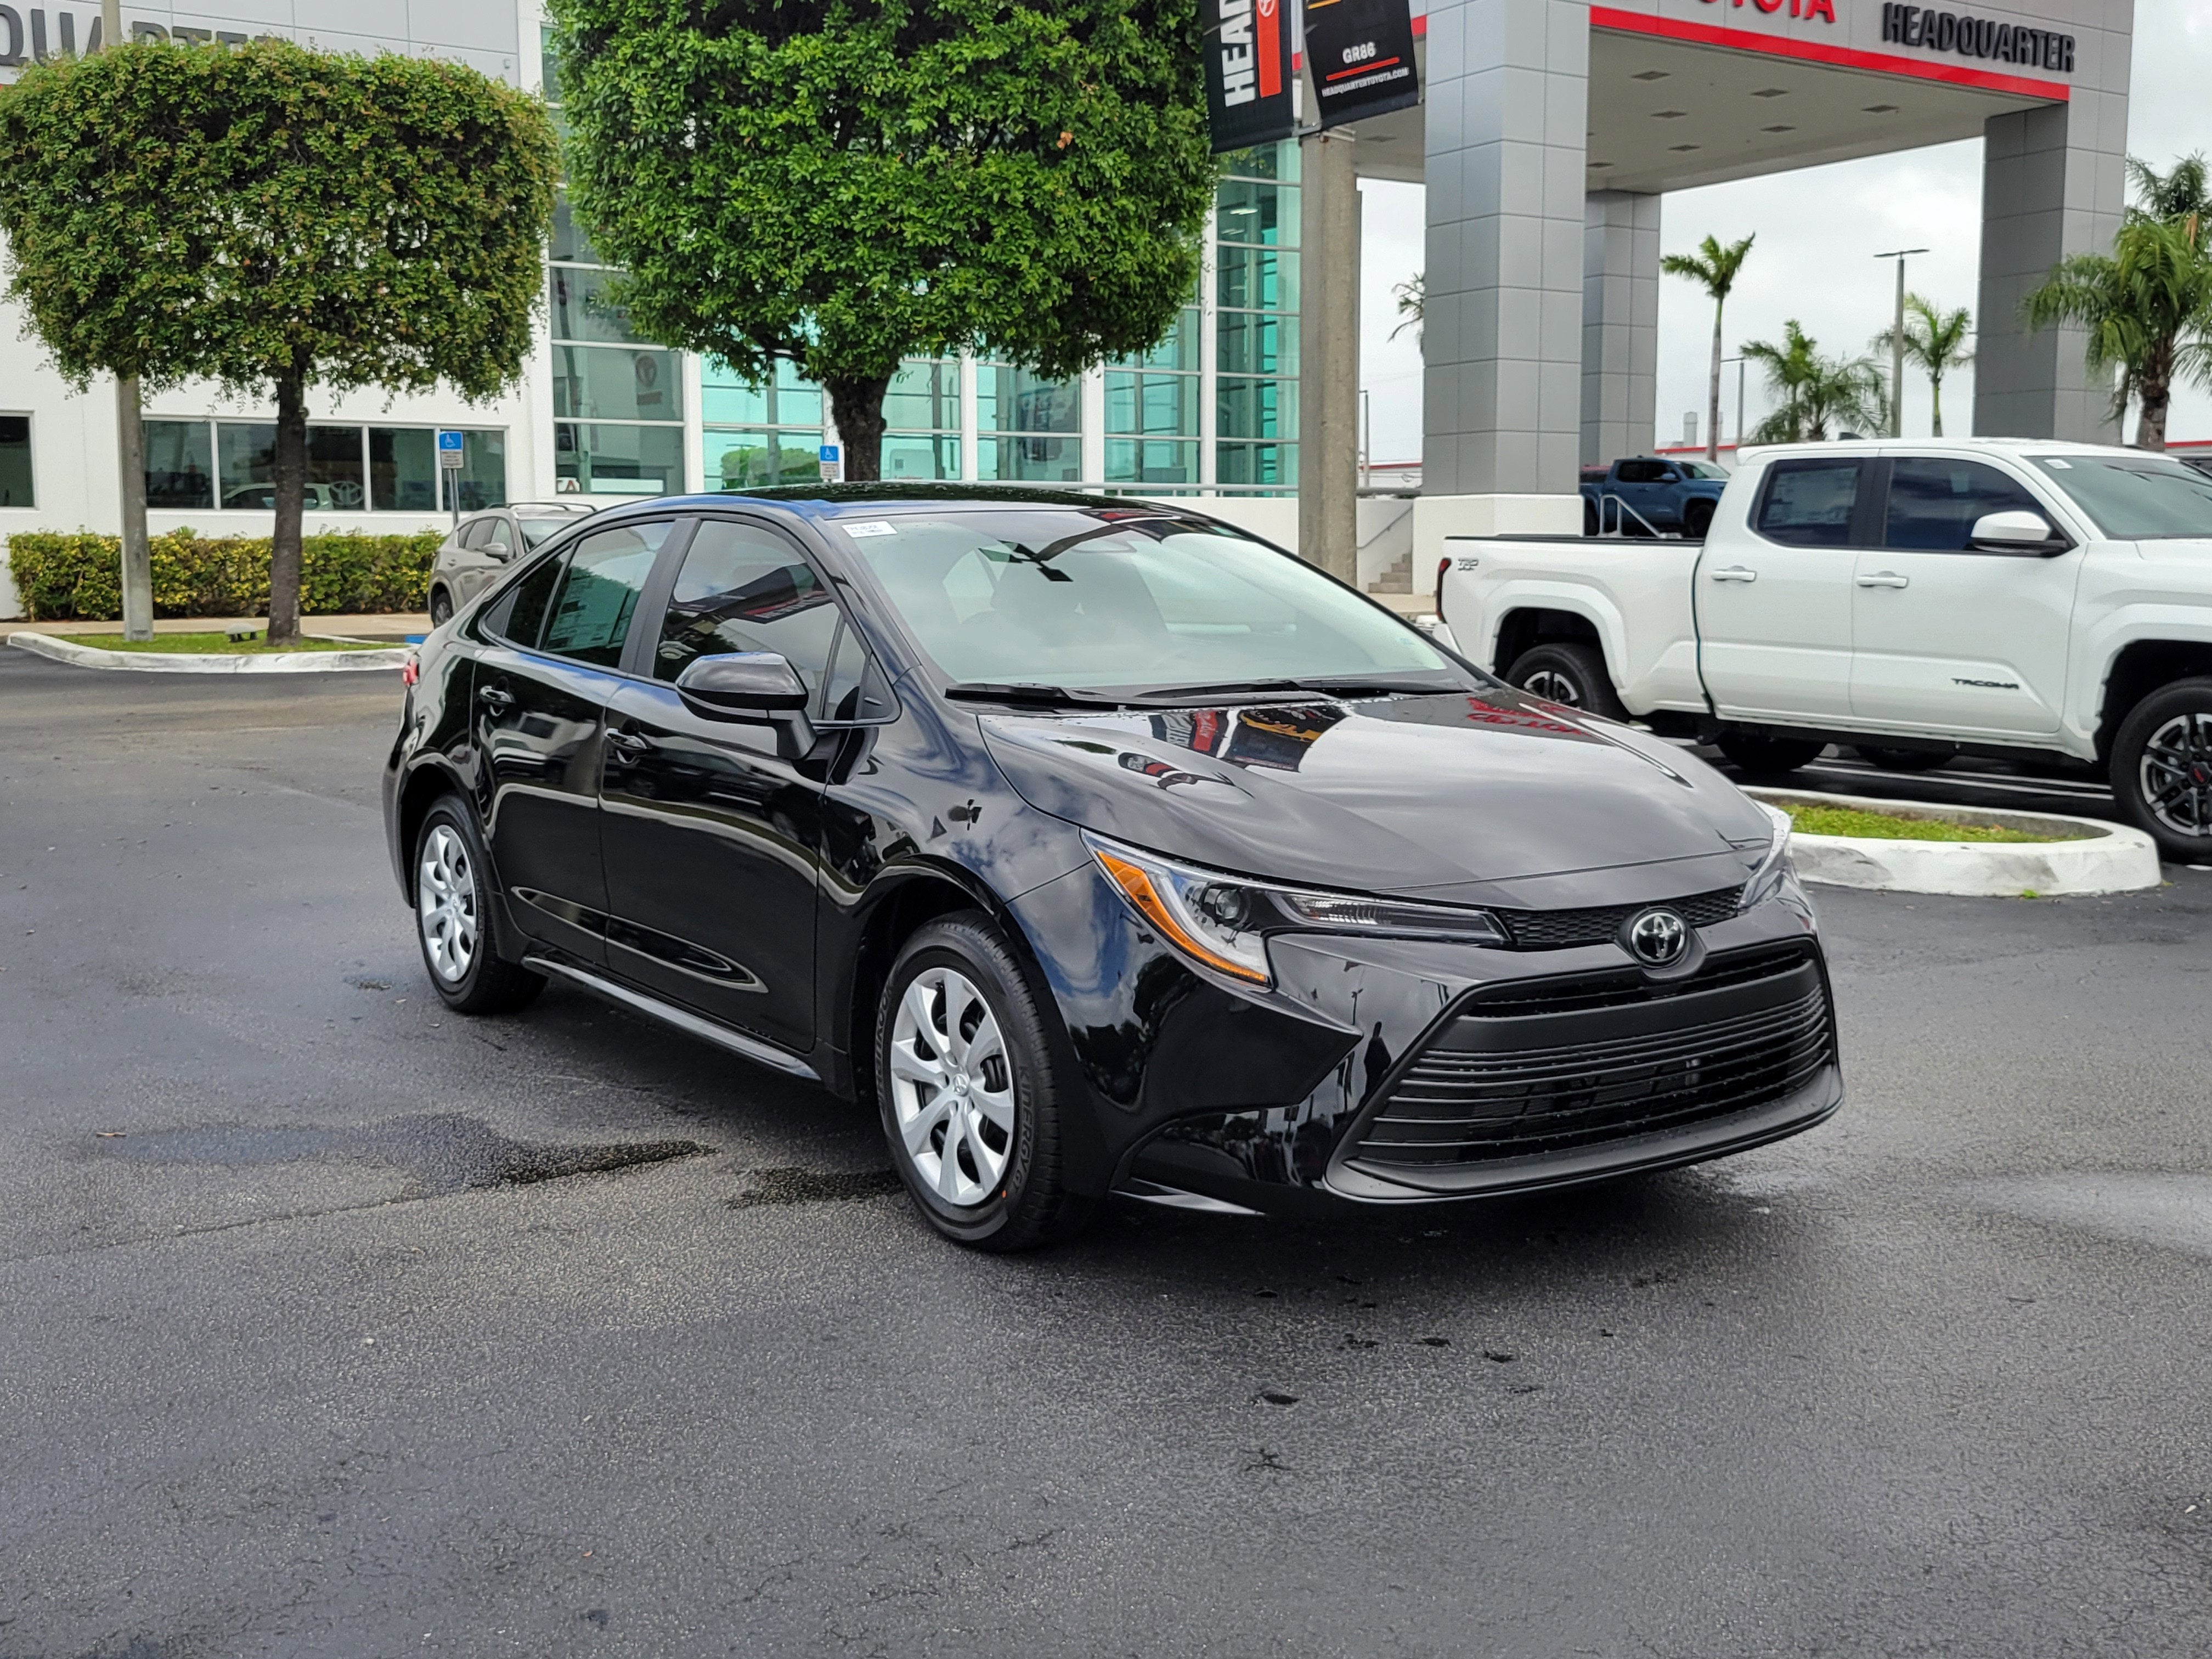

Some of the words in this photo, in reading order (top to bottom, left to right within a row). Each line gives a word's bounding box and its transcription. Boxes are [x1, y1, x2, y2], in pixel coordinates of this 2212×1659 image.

[1883, 3, 2075, 72] HEADQUARTER
[1342, 41, 1376, 64] GR86
[1951, 678, 2019, 690] TACOMA
